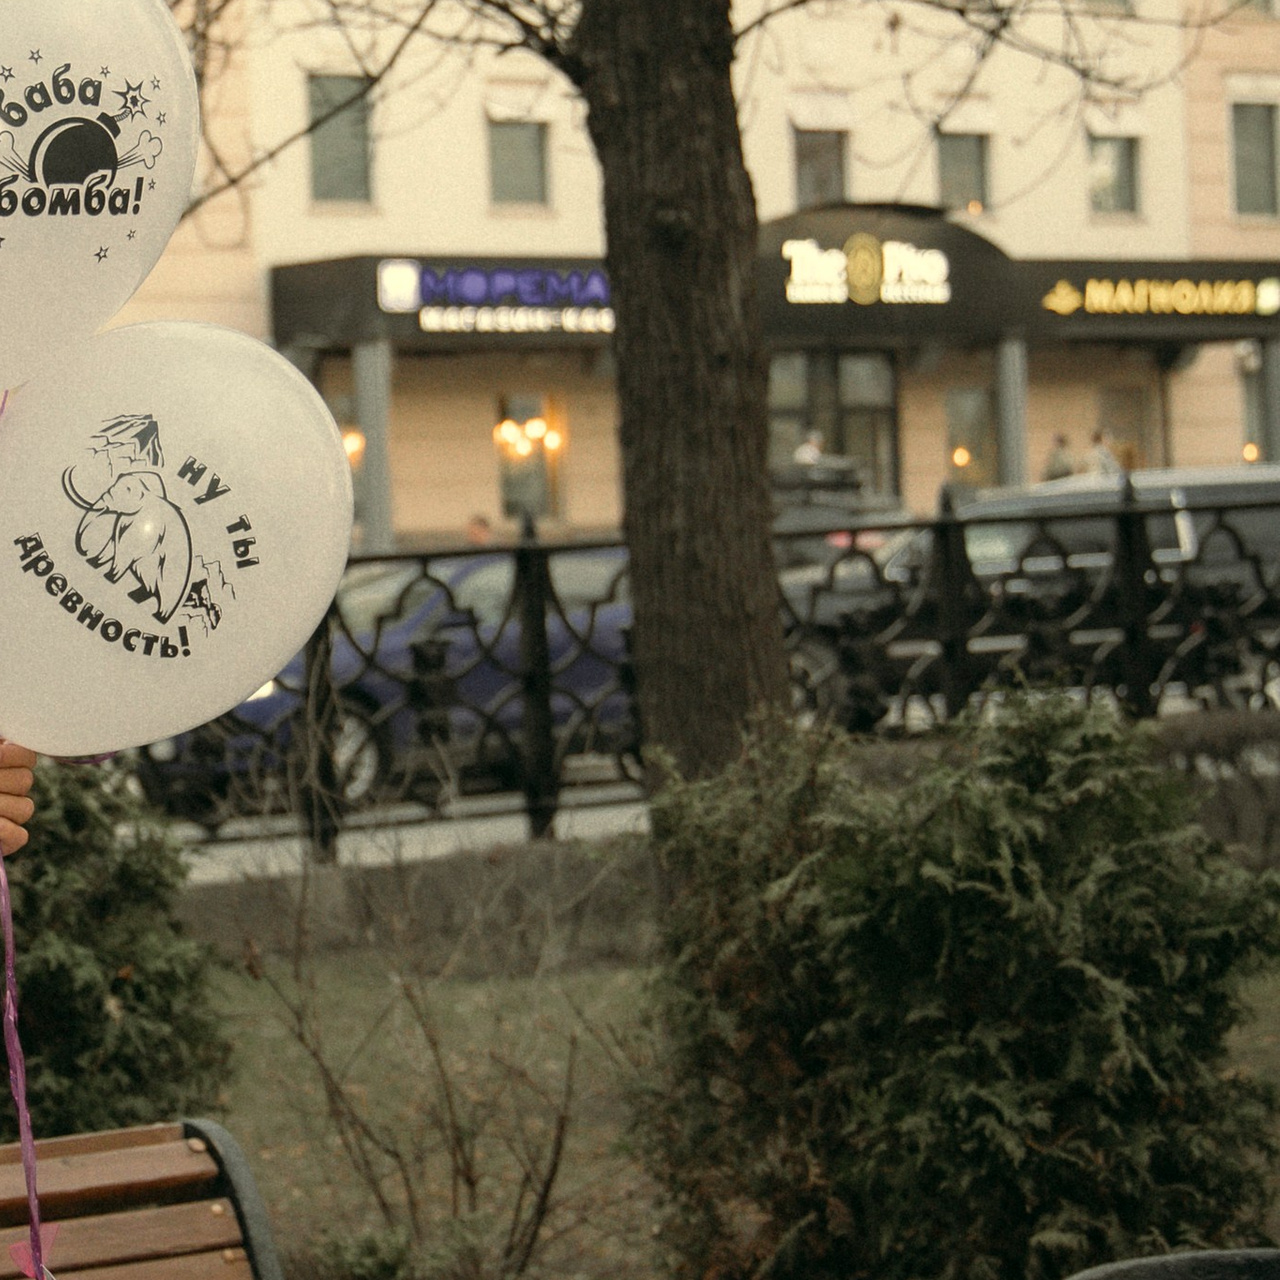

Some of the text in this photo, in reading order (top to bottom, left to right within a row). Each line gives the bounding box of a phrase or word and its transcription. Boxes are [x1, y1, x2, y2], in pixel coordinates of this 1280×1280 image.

[421, 267, 610, 305] МОРЕМА
[1084, 278, 1256, 314] МАГНОЛИЯ
[225, 513, 261, 570] ты
[13, 532, 192, 658] древность!
